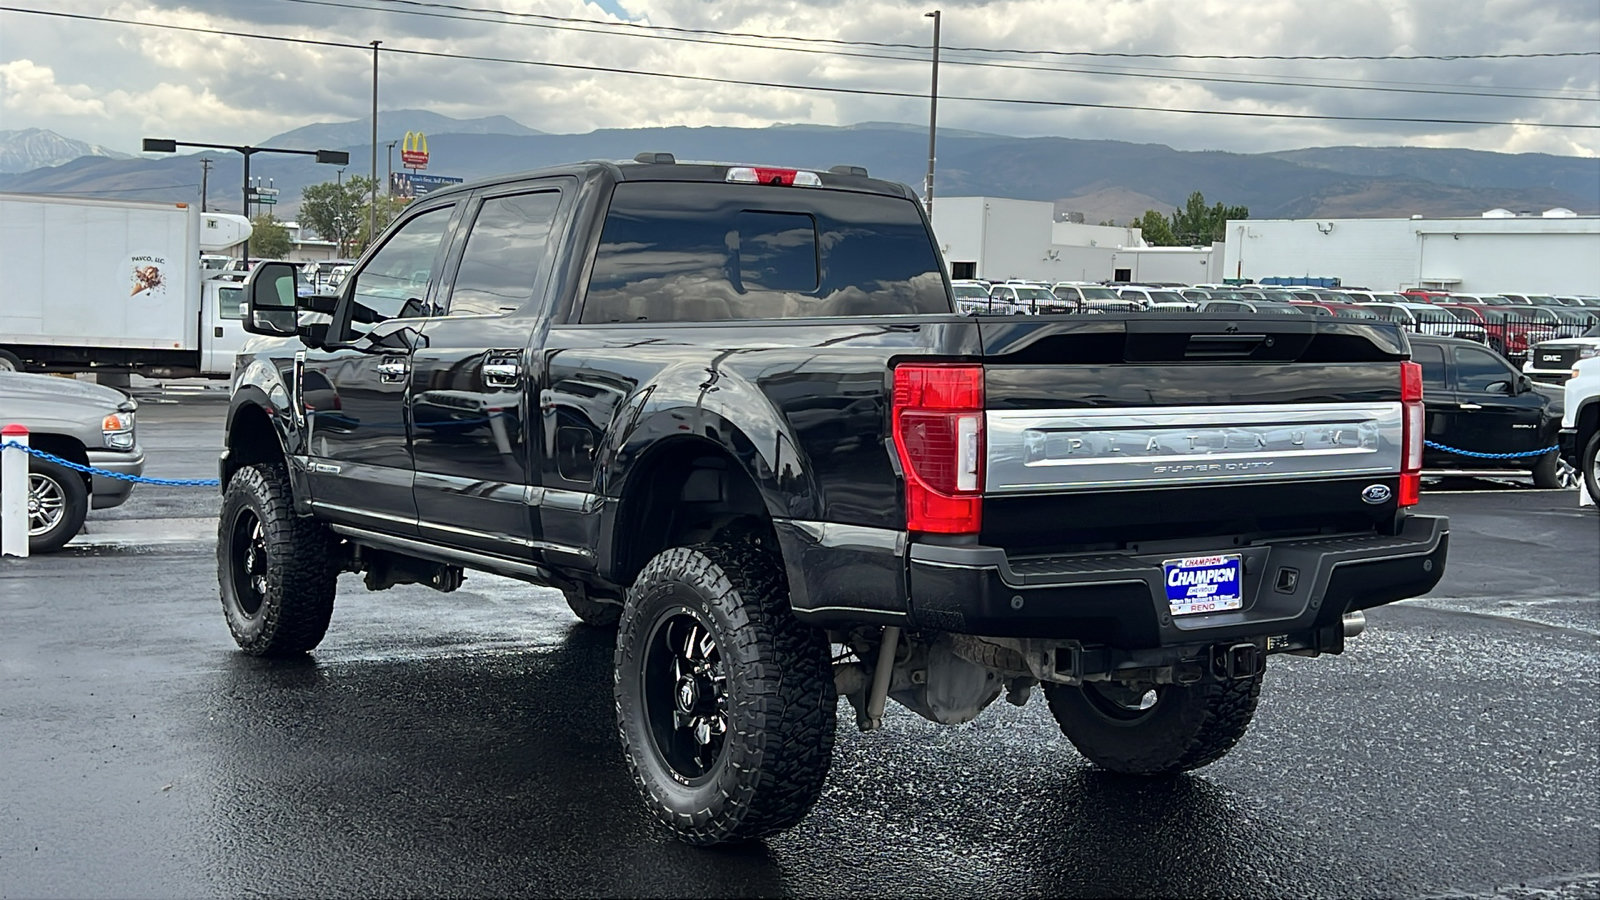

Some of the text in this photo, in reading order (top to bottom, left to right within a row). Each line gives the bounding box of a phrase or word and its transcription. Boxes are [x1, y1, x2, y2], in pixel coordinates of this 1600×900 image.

[1543, 354, 1561, 362] GMC
[1067, 430, 1343, 453] PLATINUM
[1153, 461, 1274, 473] SUPER DUTY
[1185, 557, 1222, 567] CHAMPION
[1168, 567, 1236, 587] CHAMPION
[1191, 603, 1215, 612] RENO
